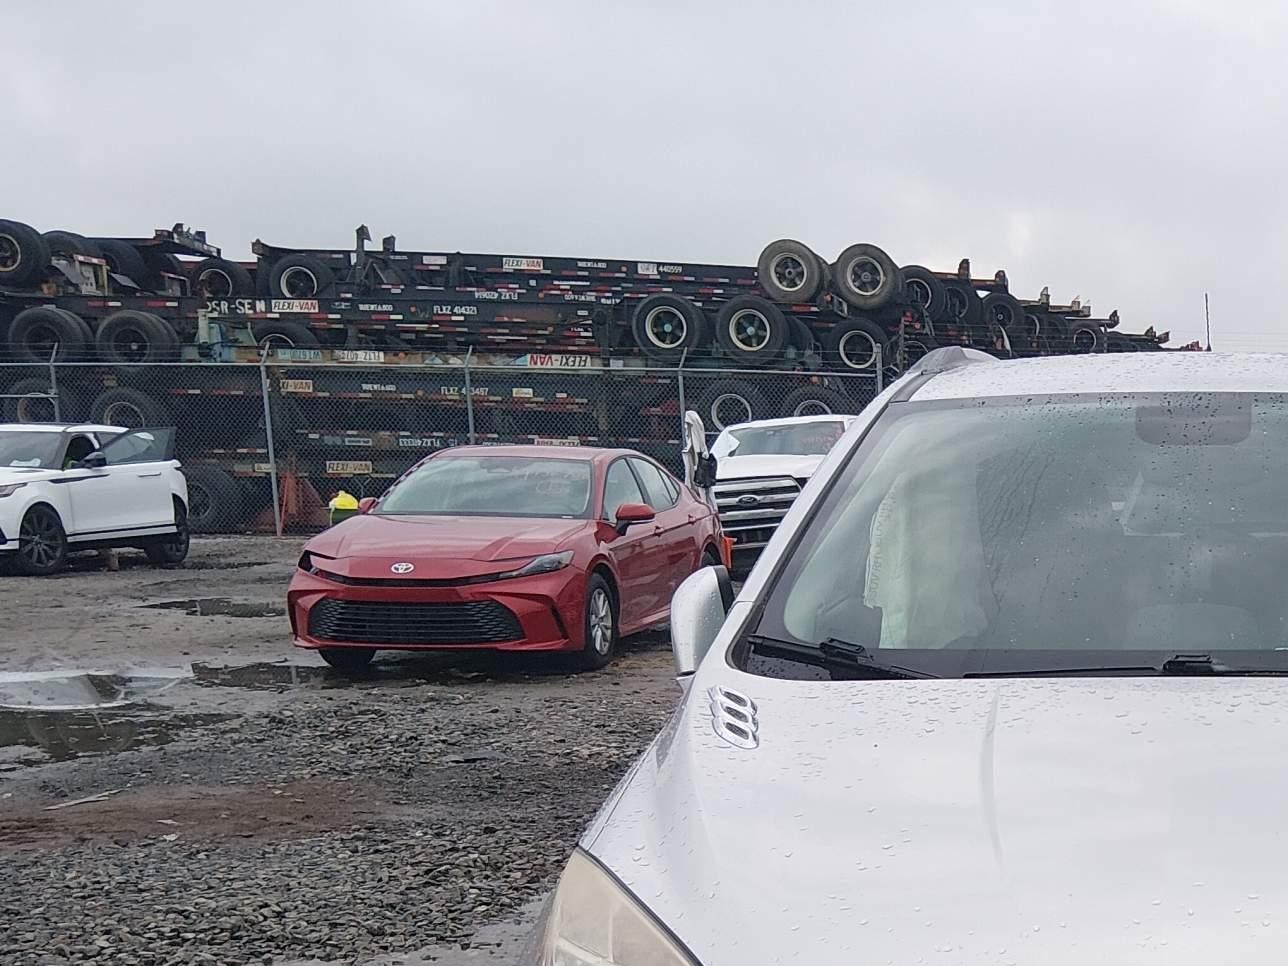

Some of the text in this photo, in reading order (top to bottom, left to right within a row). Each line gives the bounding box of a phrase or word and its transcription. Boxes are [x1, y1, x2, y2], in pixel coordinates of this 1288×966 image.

[504, 258, 542, 269] FLEXI-VAN
[272, 300, 317, 311] FLEXI-VAN
[433, 305, 452, 315] FLXZ
[528, 354, 588, 368] FLEXI-VAN
[327, 463, 370, 472] FLEXI-VAN
